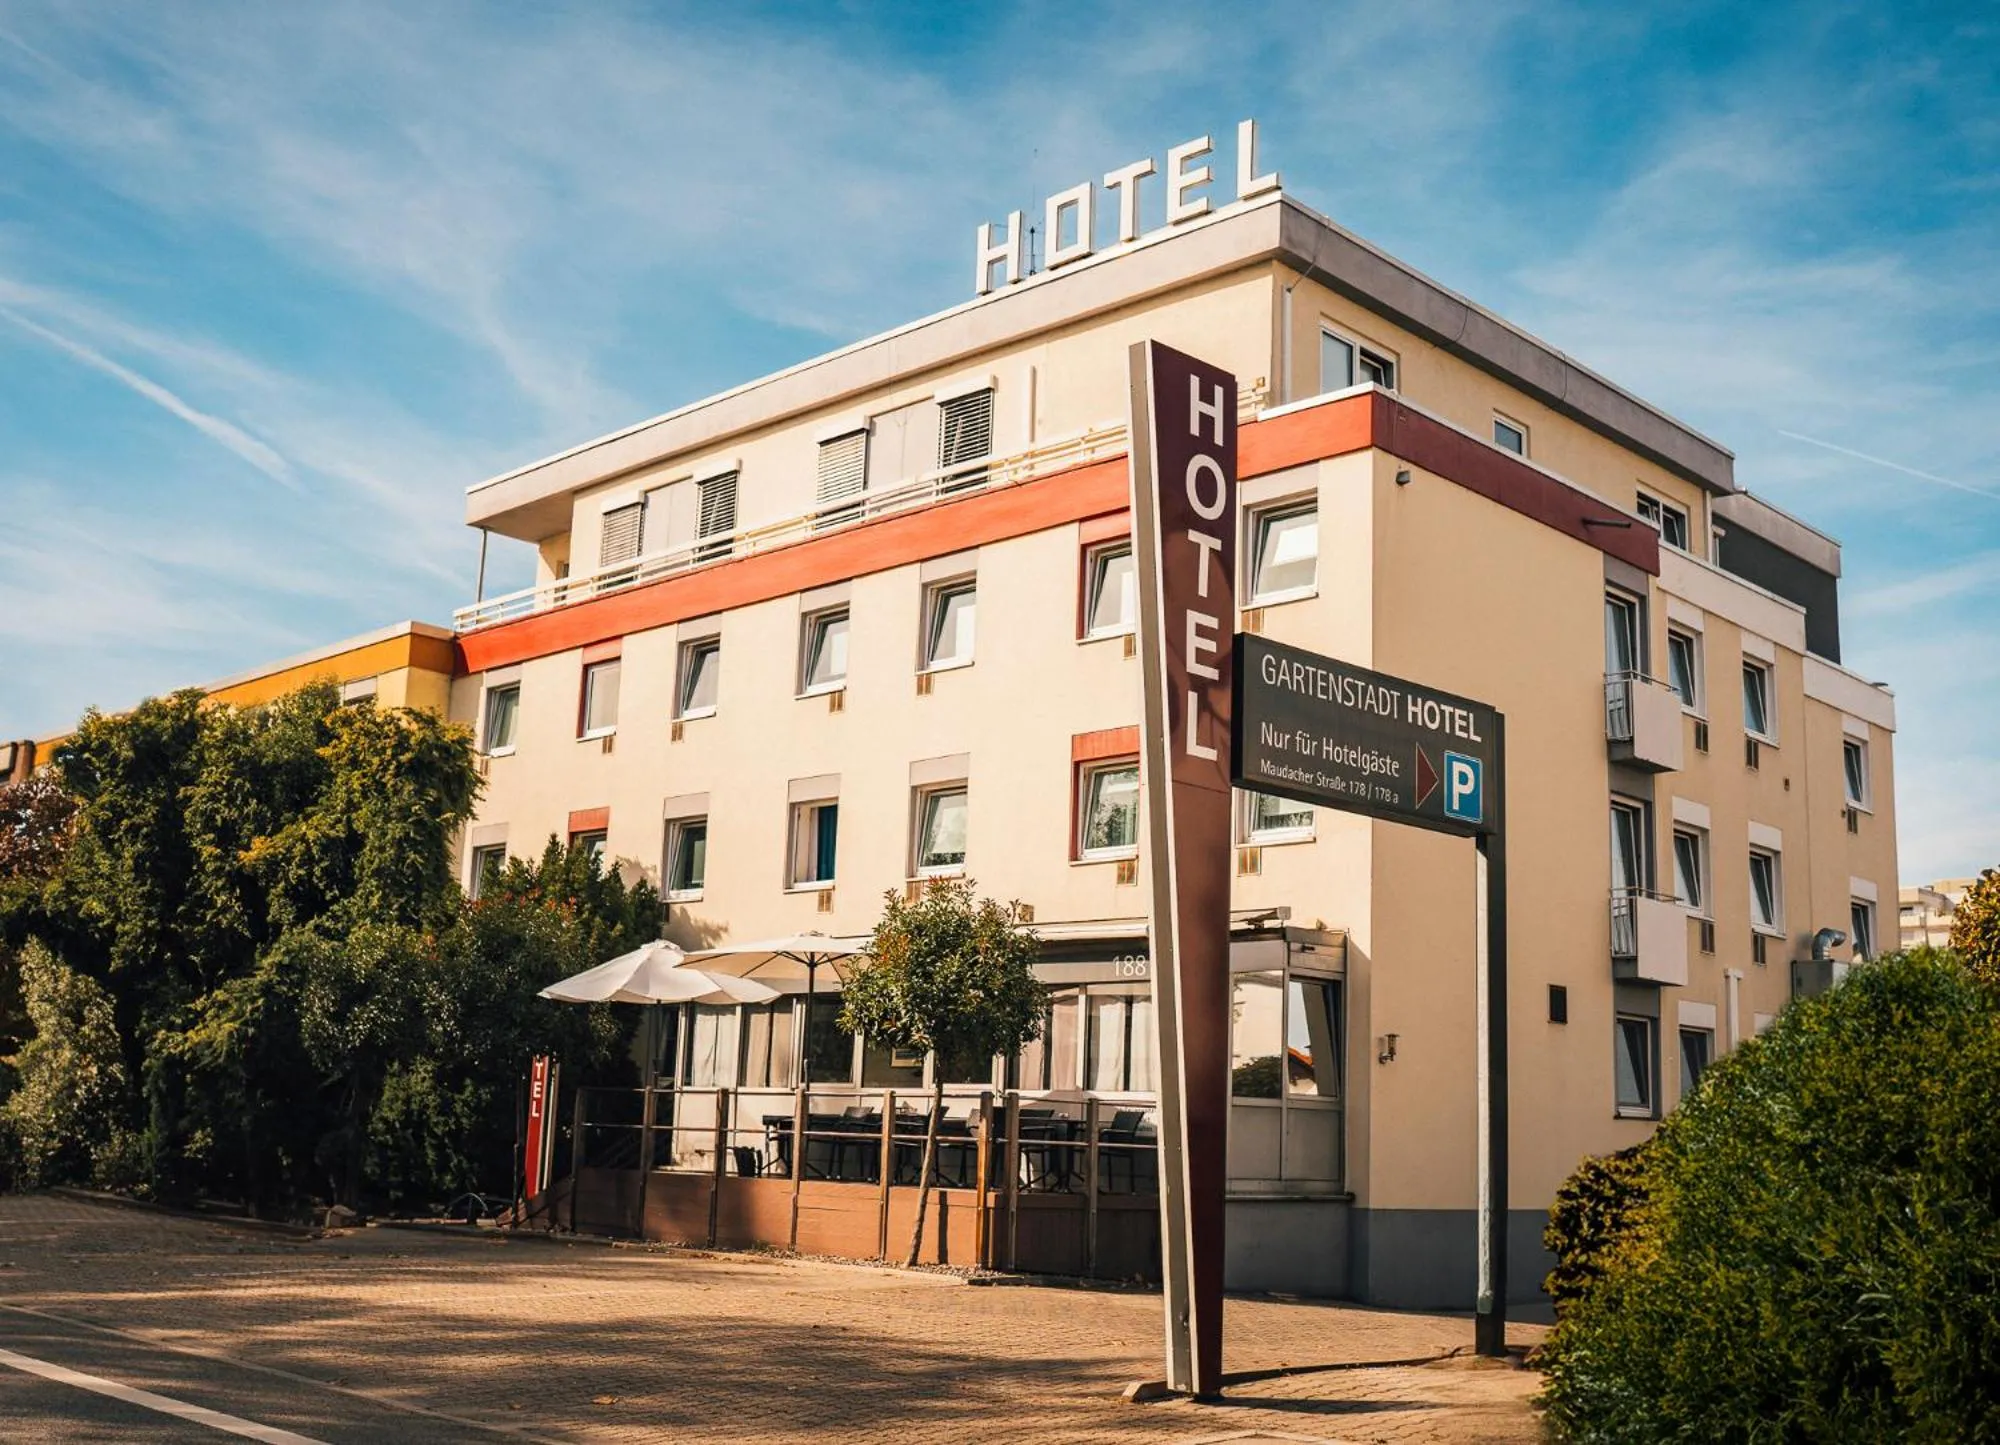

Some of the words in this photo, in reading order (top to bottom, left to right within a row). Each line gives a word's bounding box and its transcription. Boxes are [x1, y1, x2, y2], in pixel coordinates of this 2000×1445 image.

[976, 118, 1281, 295] HOTEL
[1185, 373, 1227, 763] HOTEL
[1262, 653, 1401, 719] GARTENSTADT
[1407, 694, 1482, 742] HOTEL
[1261, 721, 1291, 750] Nur
[1295, 730, 1318, 757] für
[1322, 737, 1400, 777] Hotelgäste
[1260, 759, 1314, 784] Maudacher
[1316, 771, 1347, 792] Straße
[1349, 781, 1366, 797] 178
[1375, 786, 1391, 803] 178
[1452, 761, 1475, 810] P
[1112, 955, 1147, 977] 188
